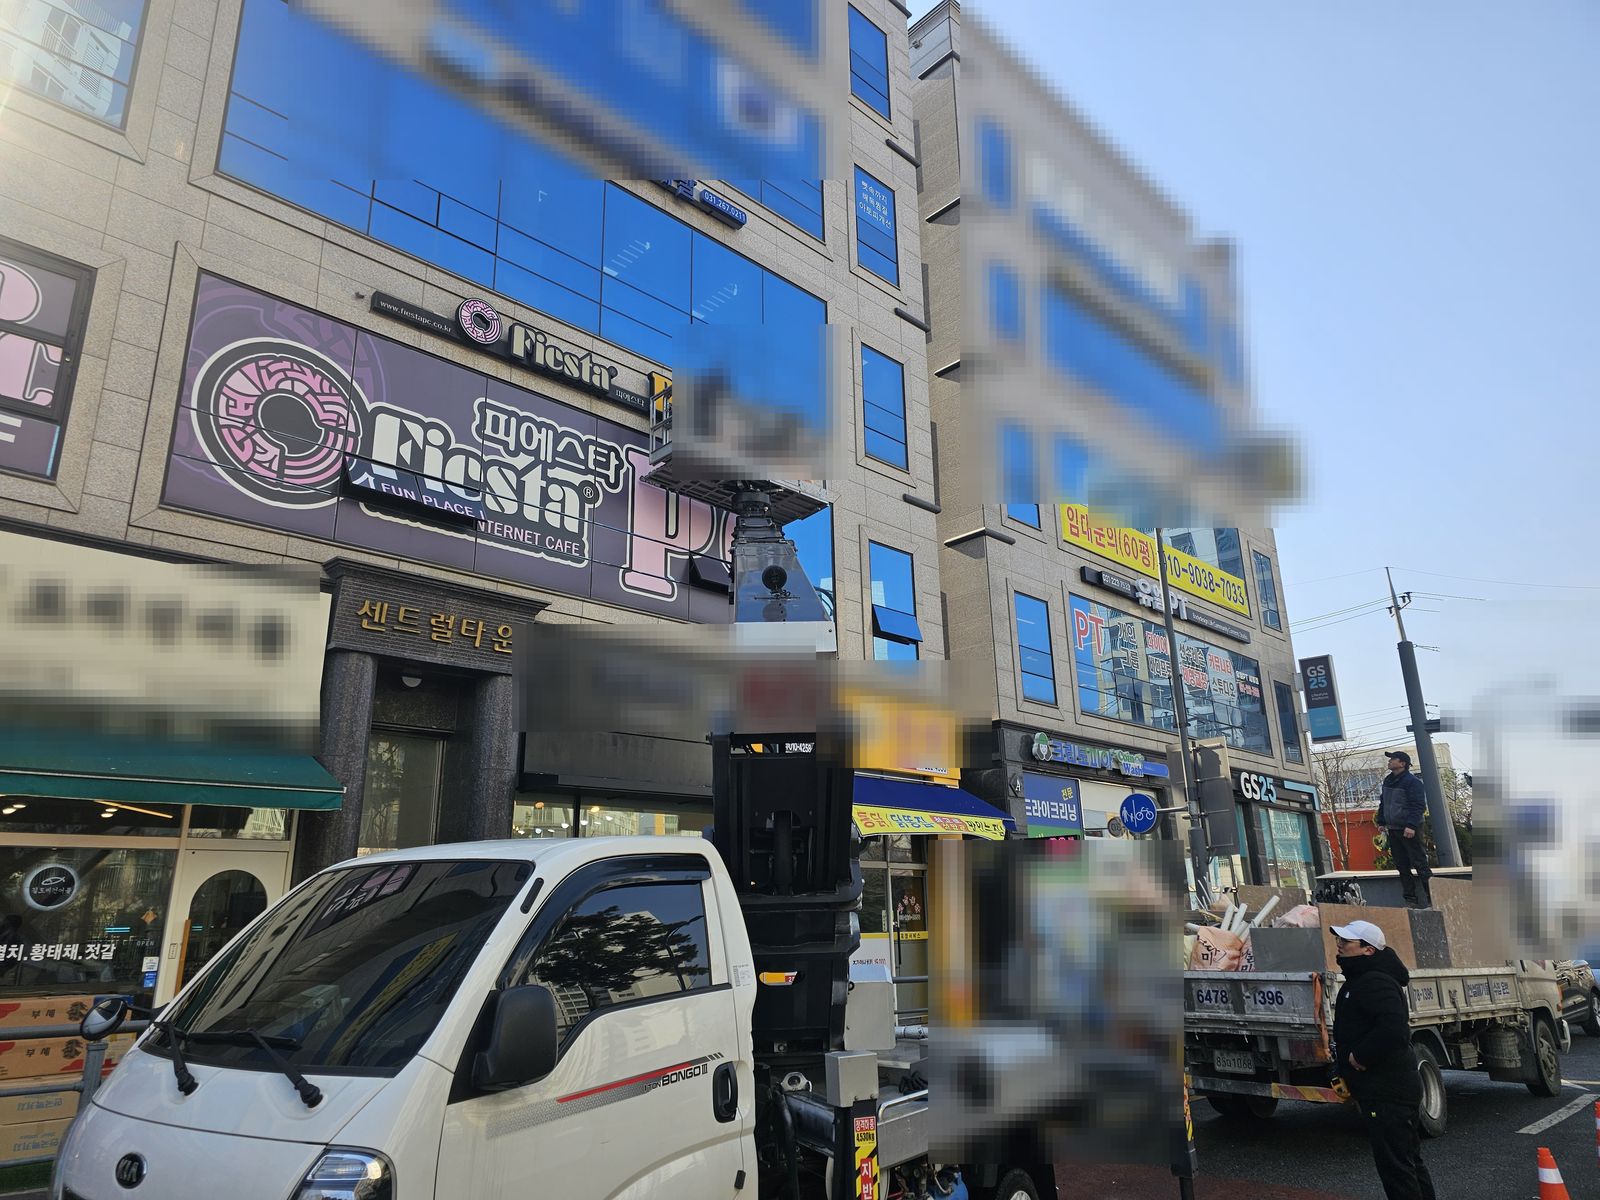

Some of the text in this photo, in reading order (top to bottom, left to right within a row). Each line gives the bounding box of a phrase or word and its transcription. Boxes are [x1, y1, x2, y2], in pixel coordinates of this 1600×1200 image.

[858, 201, 892, 230] 아토피개선
[485, 414, 622, 481] 피에스타
[380, 482, 417, 500] FUN
[422, 494, 474, 517] PLACE
[545, 535, 580, 556] CAFE
[357, 599, 512, 653] 센트럴타운
[1074, 608, 1104, 656] PT
[1117, 621, 1137, 646] 개인
[1120, 646, 1140, 671] 그룹
[1208, 653, 1233, 676] 커뮤니티
[1307, 665, 1326, 678] GS
[1309, 676, 1328, 690] 25
[1212, 677, 1237, 703] 스튜디오
[1051, 739, 1113, 770] 크린토피아
[1122, 762, 1144, 777] Wash
[1061, 787, 1073, 800] 전문
[1240, 771, 1277, 804] GS25
[1197, 989, 1228, 1005] 6478
[662, 1065, 701, 1087] BONGO
